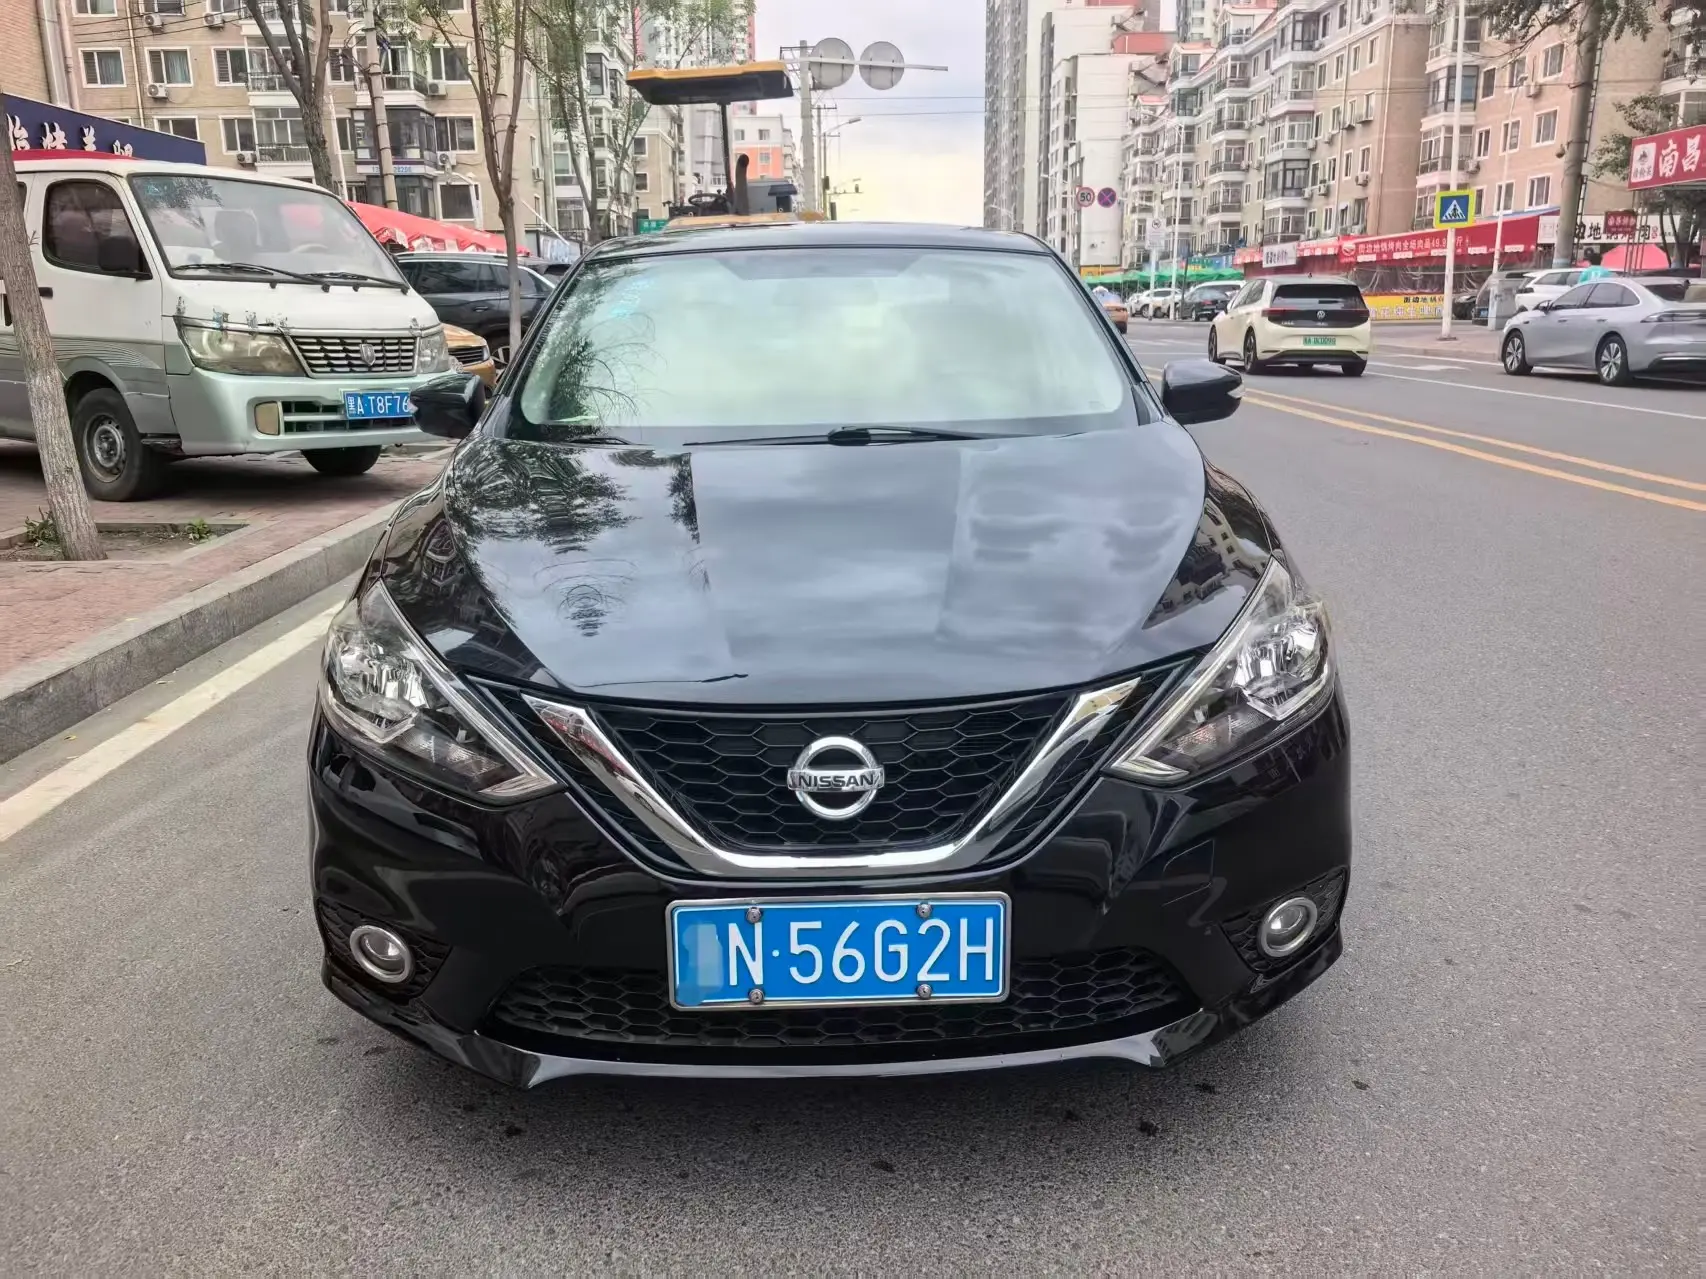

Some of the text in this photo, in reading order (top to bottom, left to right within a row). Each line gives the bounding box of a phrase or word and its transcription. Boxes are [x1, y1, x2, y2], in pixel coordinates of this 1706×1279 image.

[1659, 134, 1701, 177] 南昌
[1080, 192, 1091, 202] 50
[799, 774, 874, 788] NISSAN
[728, 917, 994, 987] N·56G2H
